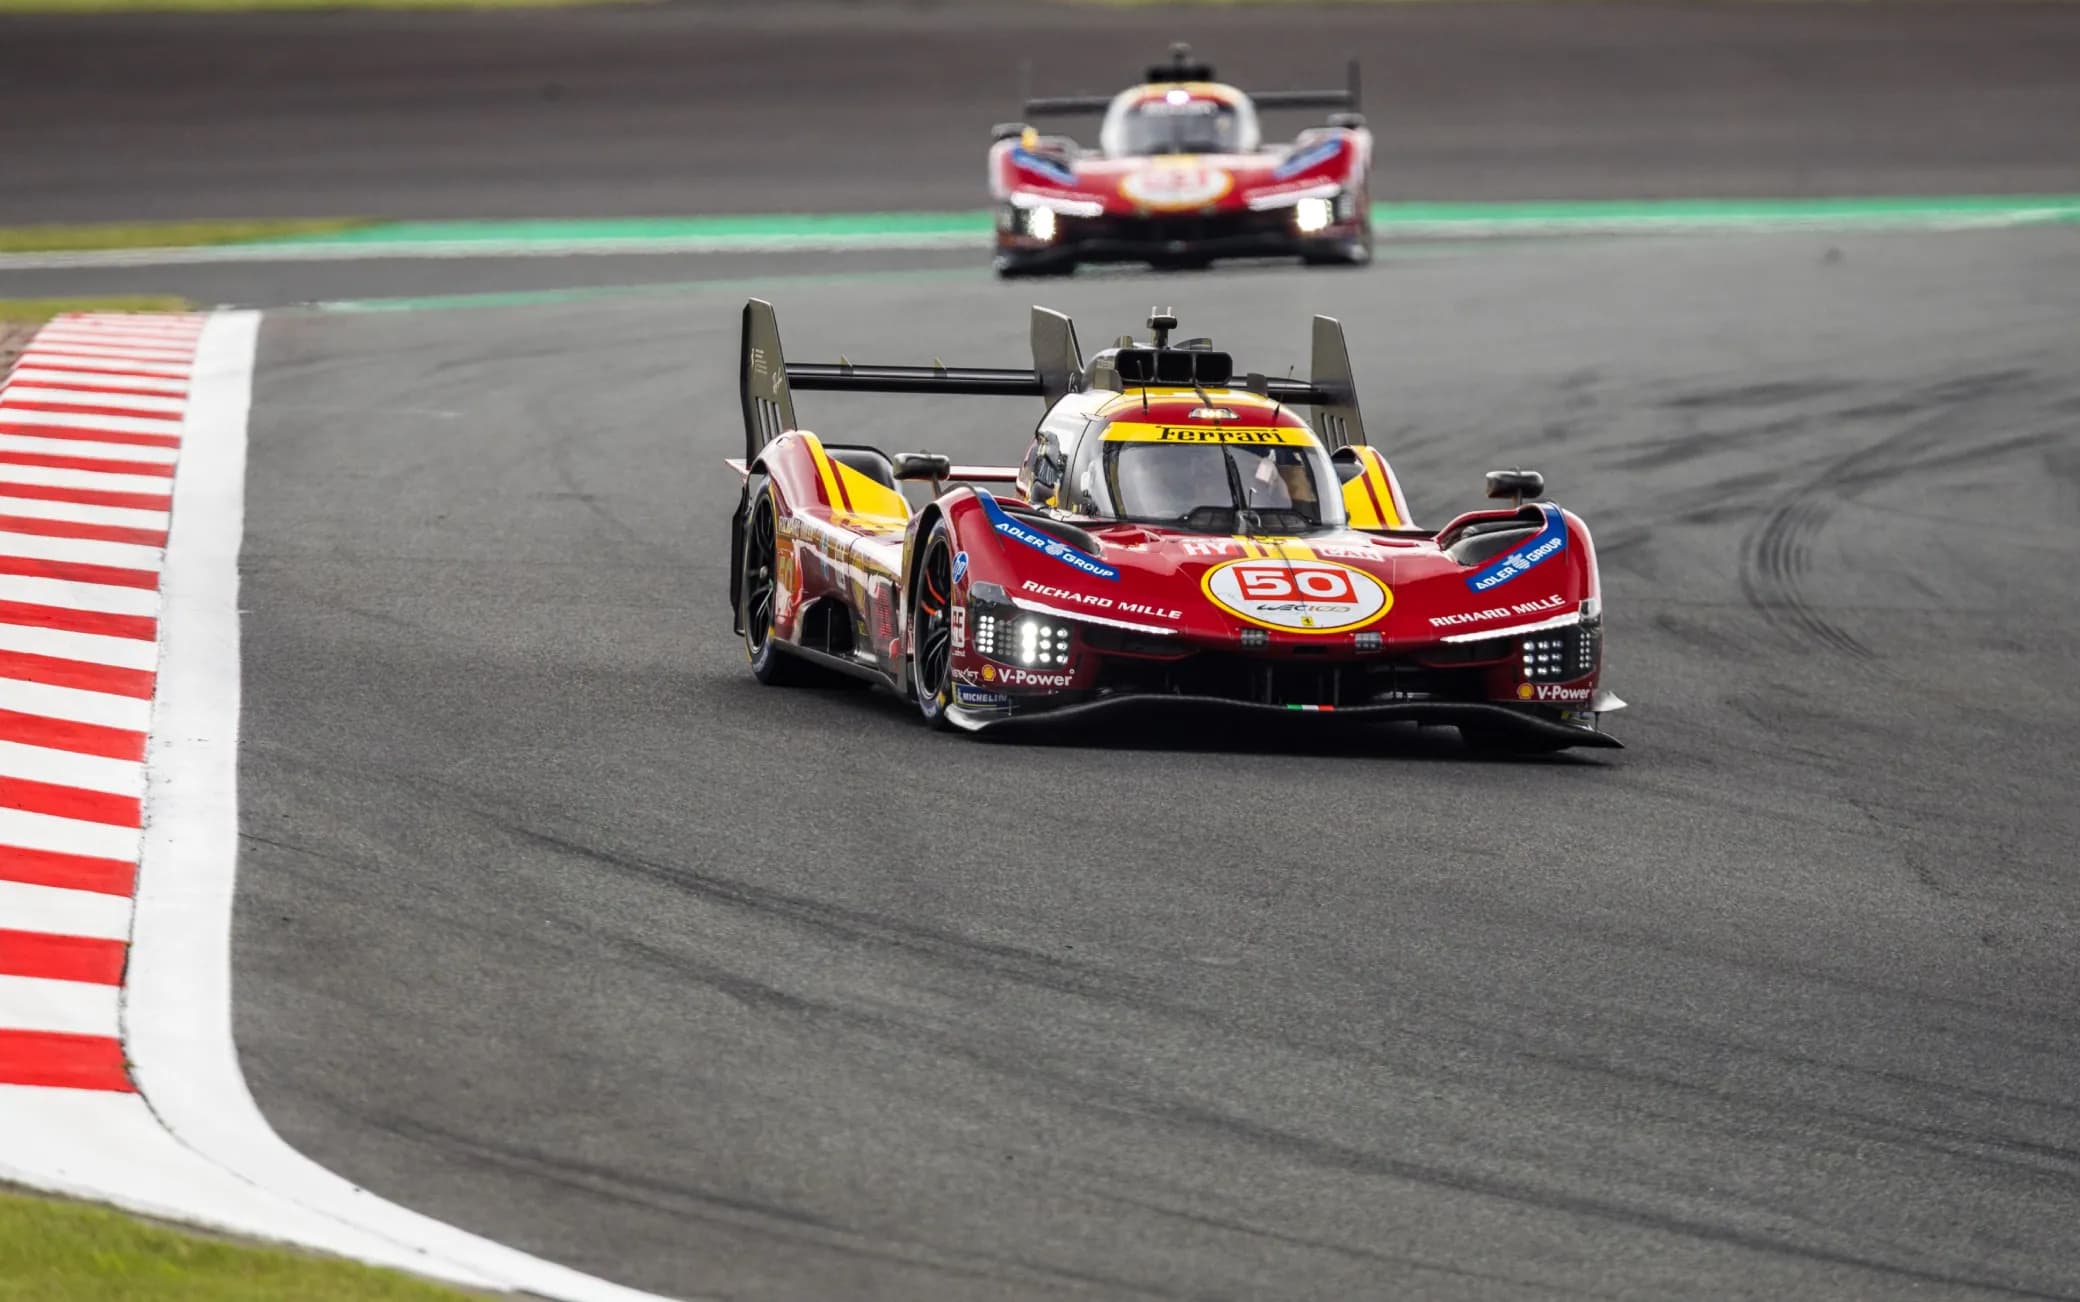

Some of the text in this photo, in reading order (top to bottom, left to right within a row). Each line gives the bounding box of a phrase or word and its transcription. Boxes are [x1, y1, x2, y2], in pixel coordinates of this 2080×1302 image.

[1156, 426, 1288, 443] Ferrari
[995, 523, 1115, 577] ADLER GROUP
[1475, 537, 1562, 590] ADLER GROUP
[1241, 570, 1348, 598] 50
[1022, 580, 1183, 619] RICHARD MILLE
[1429, 594, 1566, 627] RICHARD MILLE
[998, 668, 1072, 686] V-Power
[1537, 685, 1590, 700] V-Power
